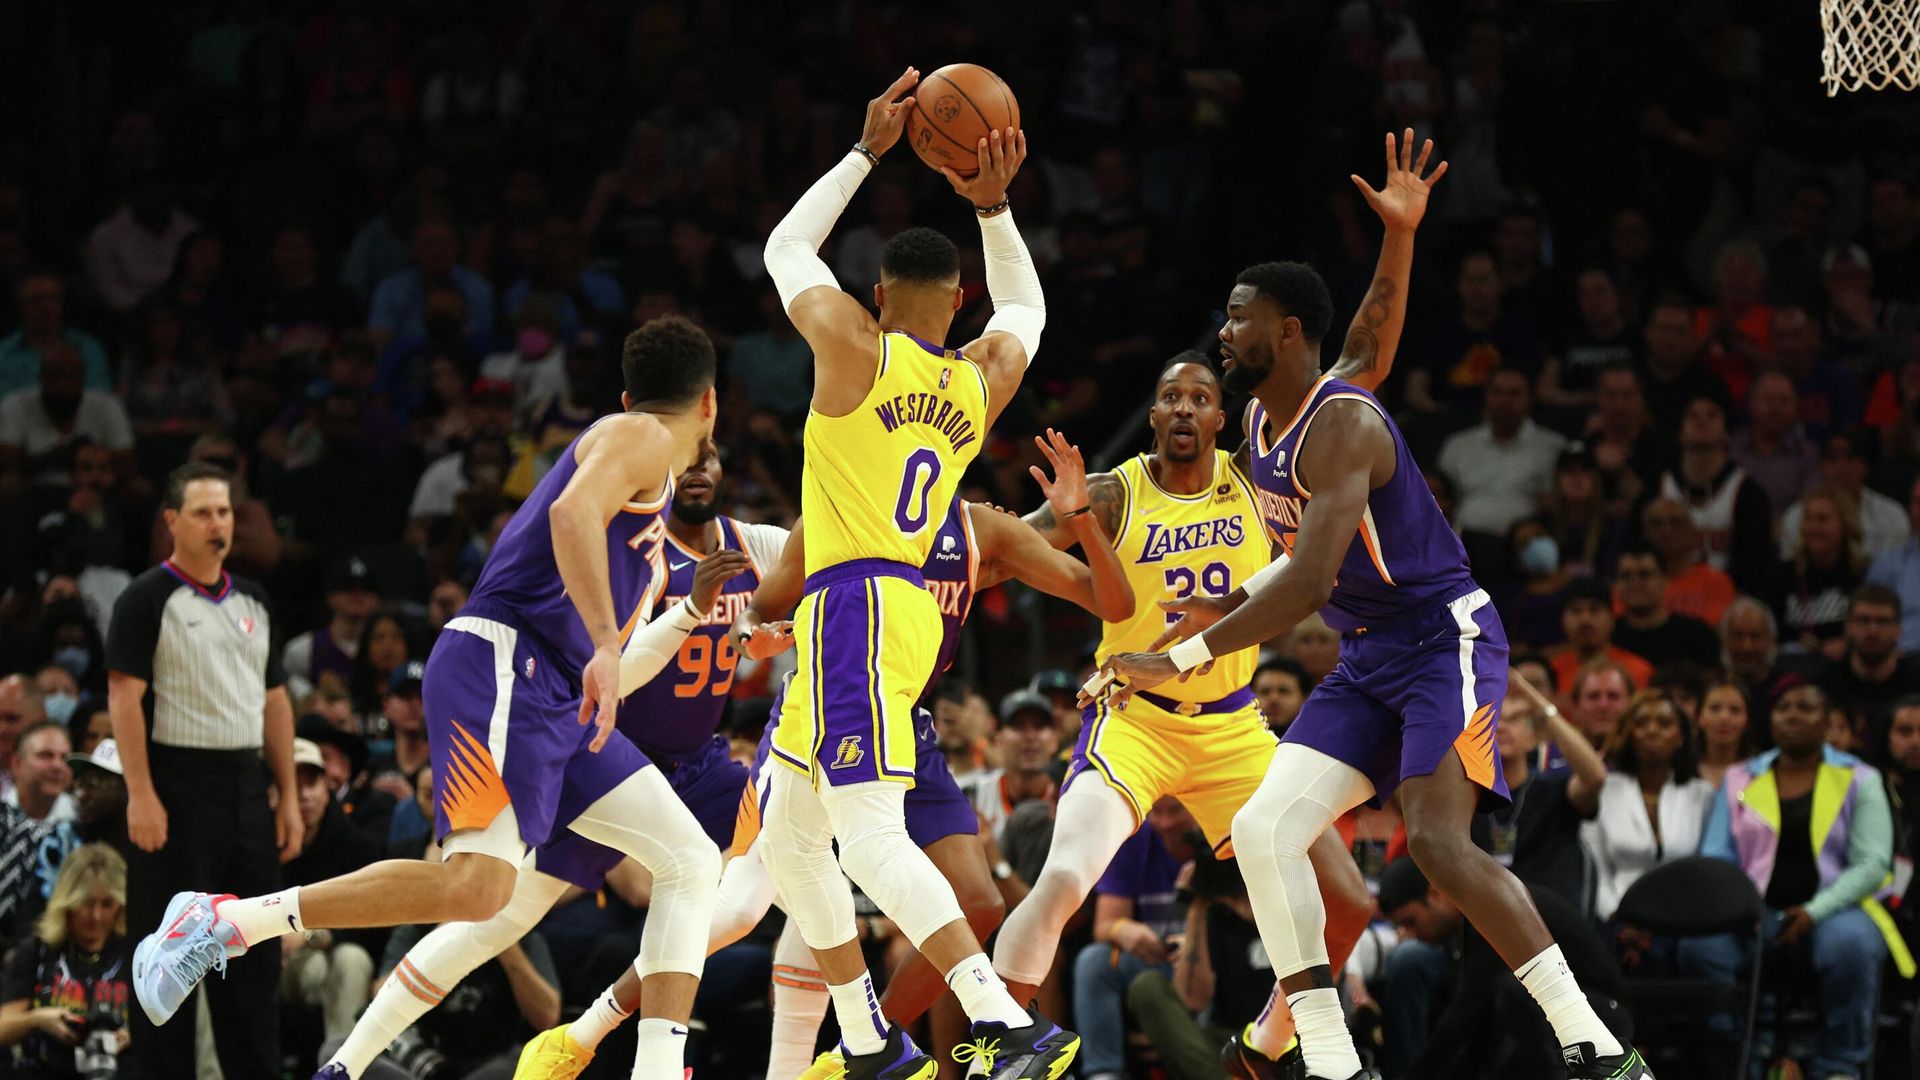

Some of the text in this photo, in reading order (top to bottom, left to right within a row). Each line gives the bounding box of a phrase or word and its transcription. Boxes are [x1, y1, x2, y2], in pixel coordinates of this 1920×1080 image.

[874, 392, 976, 455] WESTBROOK
[893, 447, 942, 538] 0
[1272, 469, 1288, 478] PayPal
[1214, 493, 1240, 505] bibigo
[936, 552, 961, 561] PayPal
[1135, 514, 1245, 564] LAKERS
[673, 634, 740, 698] 99
